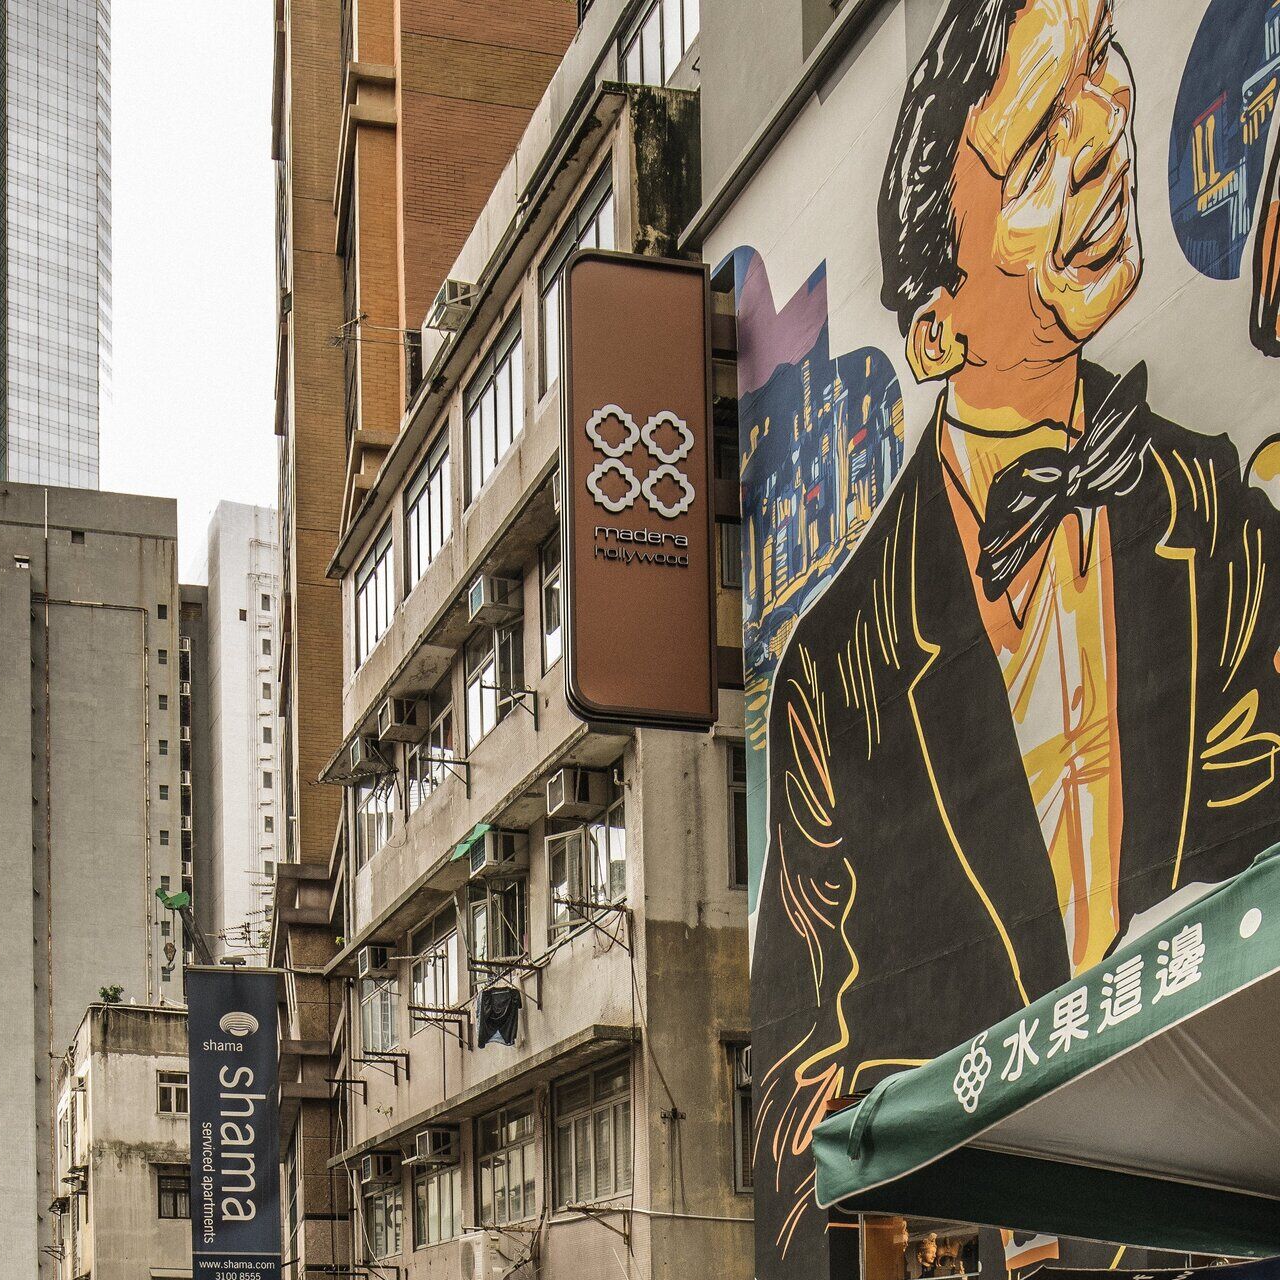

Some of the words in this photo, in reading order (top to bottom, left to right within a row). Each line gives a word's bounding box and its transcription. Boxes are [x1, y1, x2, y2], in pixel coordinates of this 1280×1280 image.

[594, 525, 688, 546] madera
[593, 545, 689, 567] hollywood
[999, 921, 1206, 1084] 水果這邊
[203, 1039, 243, 1052] shama
[202, 1121, 217, 1172] serviced
[219, 1065, 267, 1222] shama
[202, 1175, 218, 1244] apartments
[198, 1258, 275, 1271] www.shama.com
